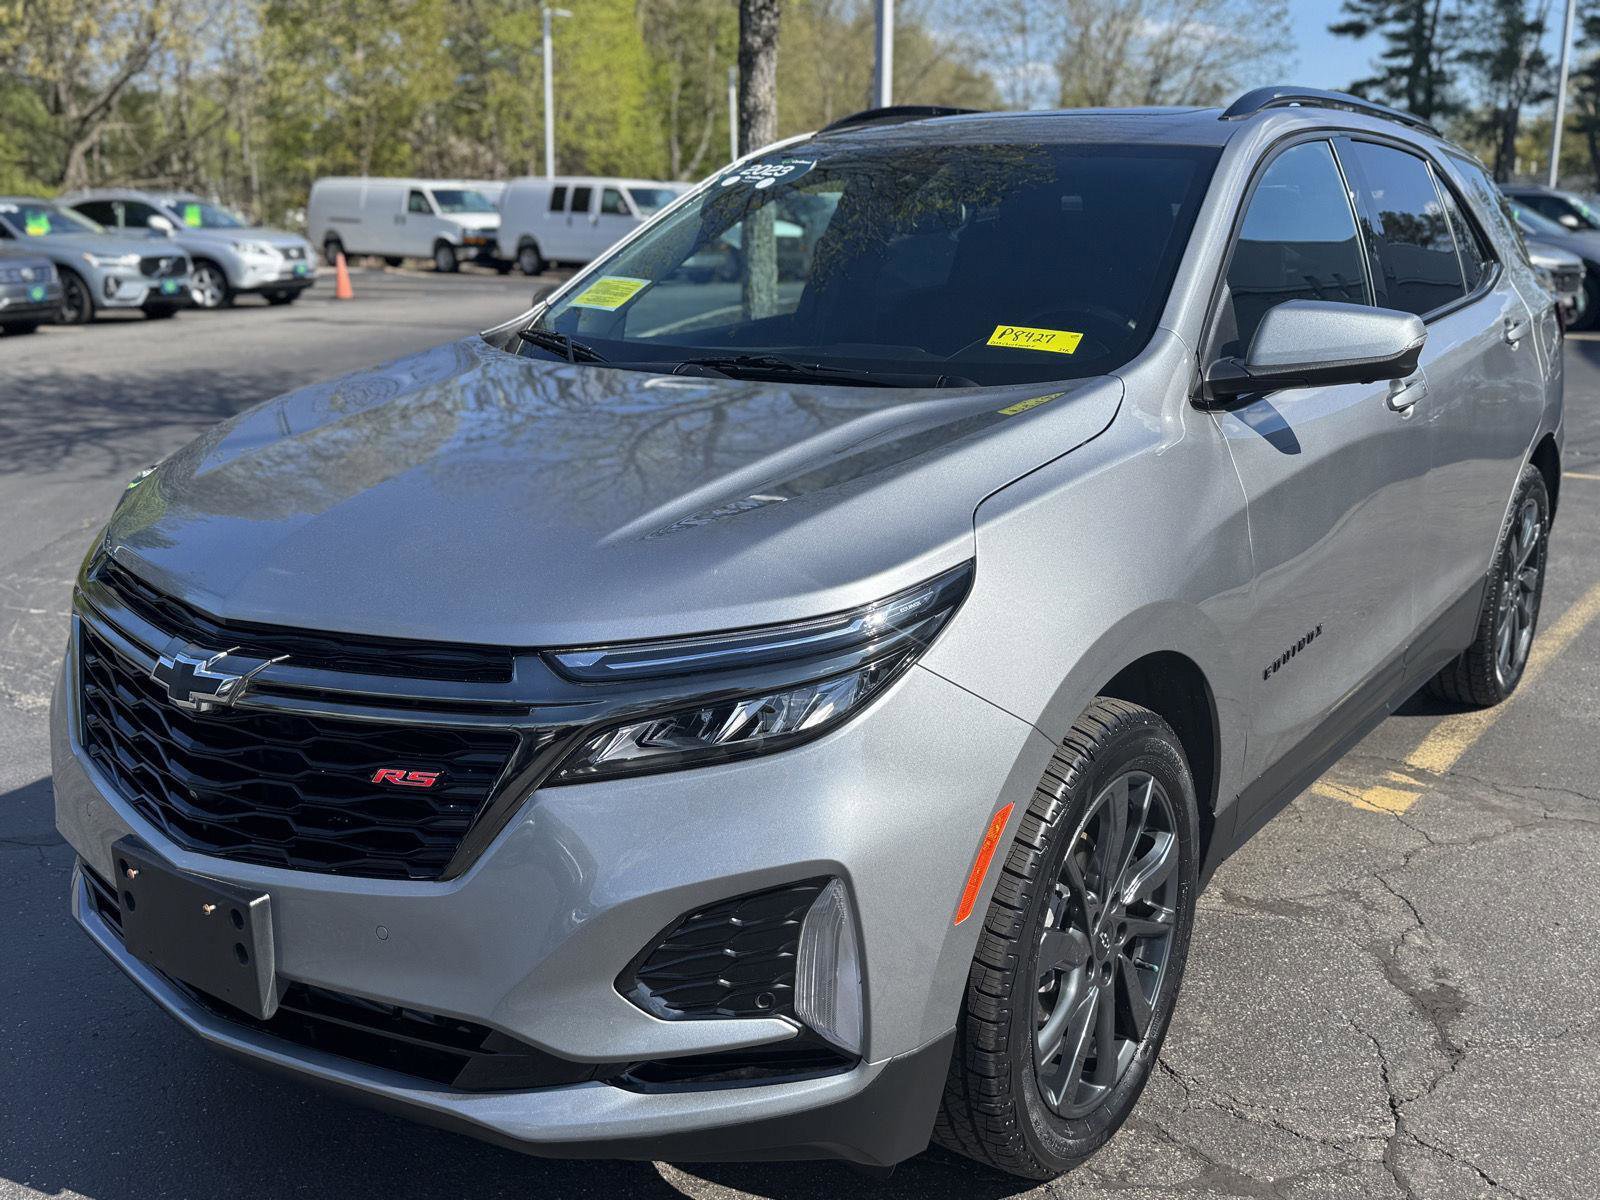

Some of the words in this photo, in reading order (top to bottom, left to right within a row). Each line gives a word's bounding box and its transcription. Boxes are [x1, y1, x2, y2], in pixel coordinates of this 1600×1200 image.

[740, 165, 795, 177] 2023
[998, 328, 1056, 343] P8427
[1262, 623, 1323, 681] EQUINOX
[372, 768, 440, 787] RS
